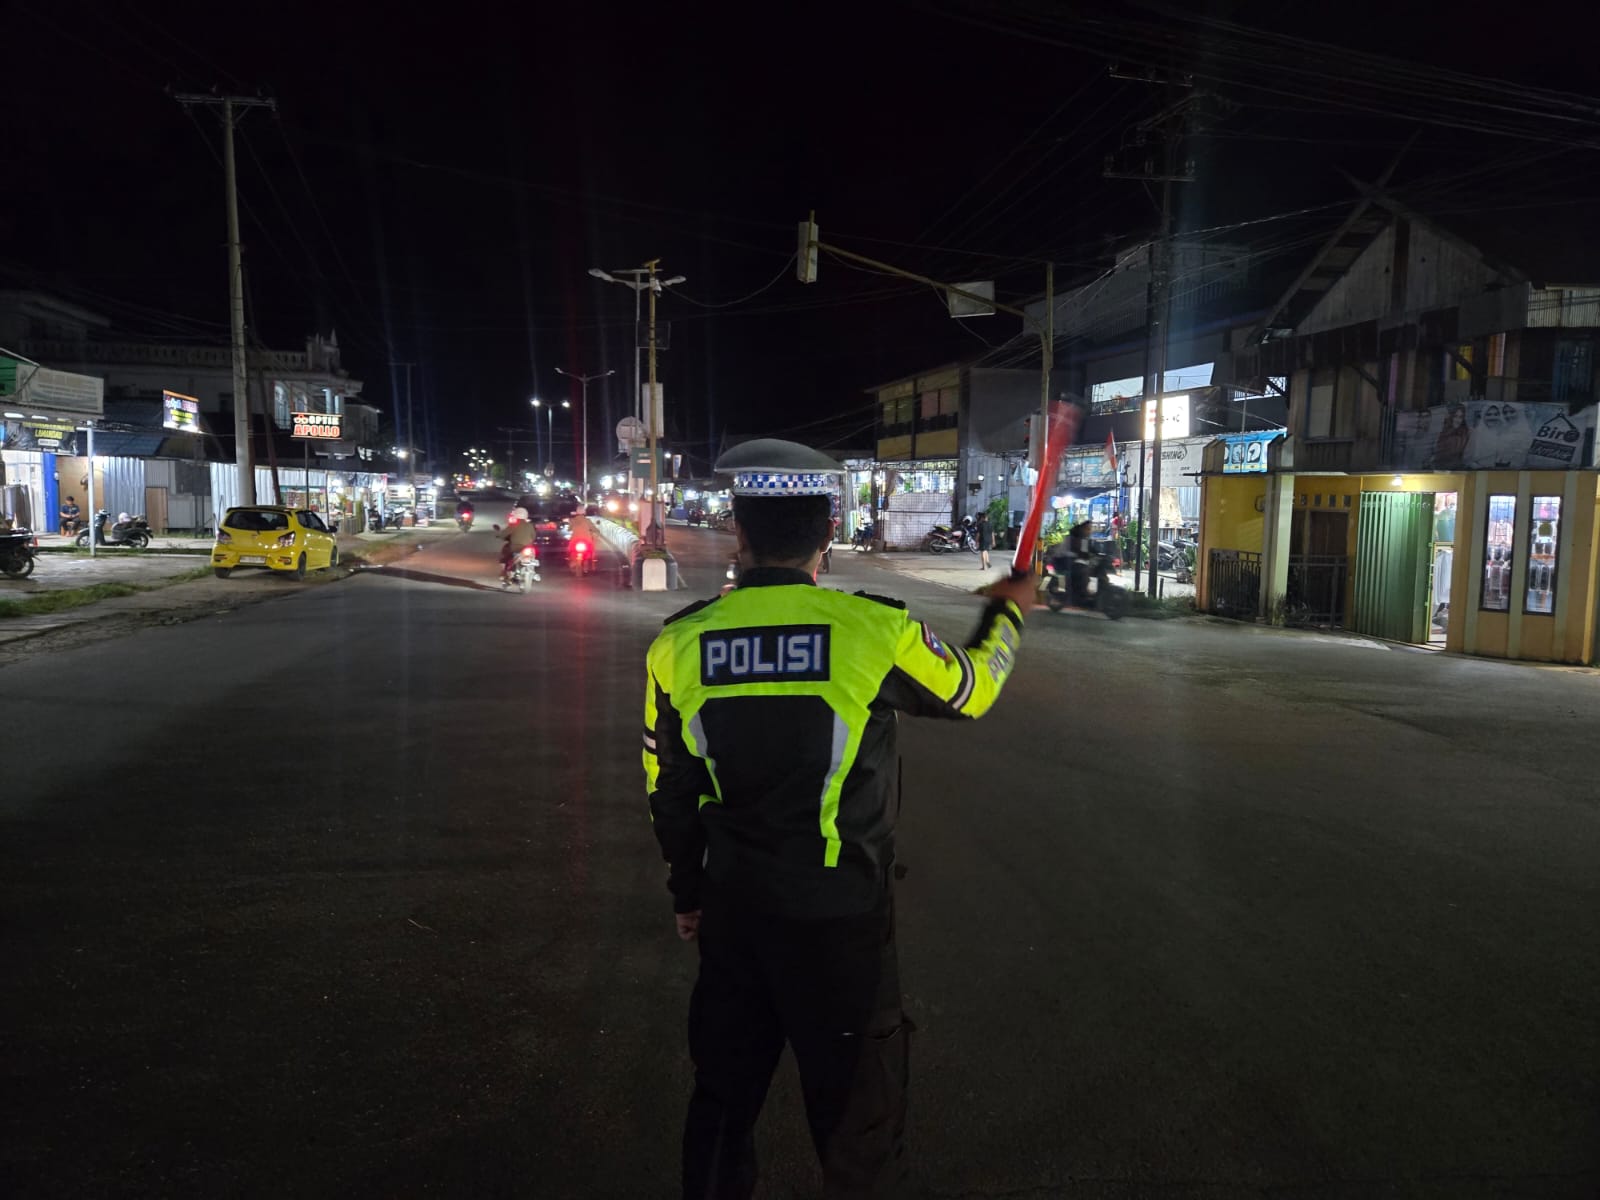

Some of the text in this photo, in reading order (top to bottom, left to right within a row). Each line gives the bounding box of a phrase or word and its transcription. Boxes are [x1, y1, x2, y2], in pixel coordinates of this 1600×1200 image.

[309, 415, 340, 425] OPTIK
[293, 424, 340, 437] APOLLO
[706, 634, 823, 677] POLISI
